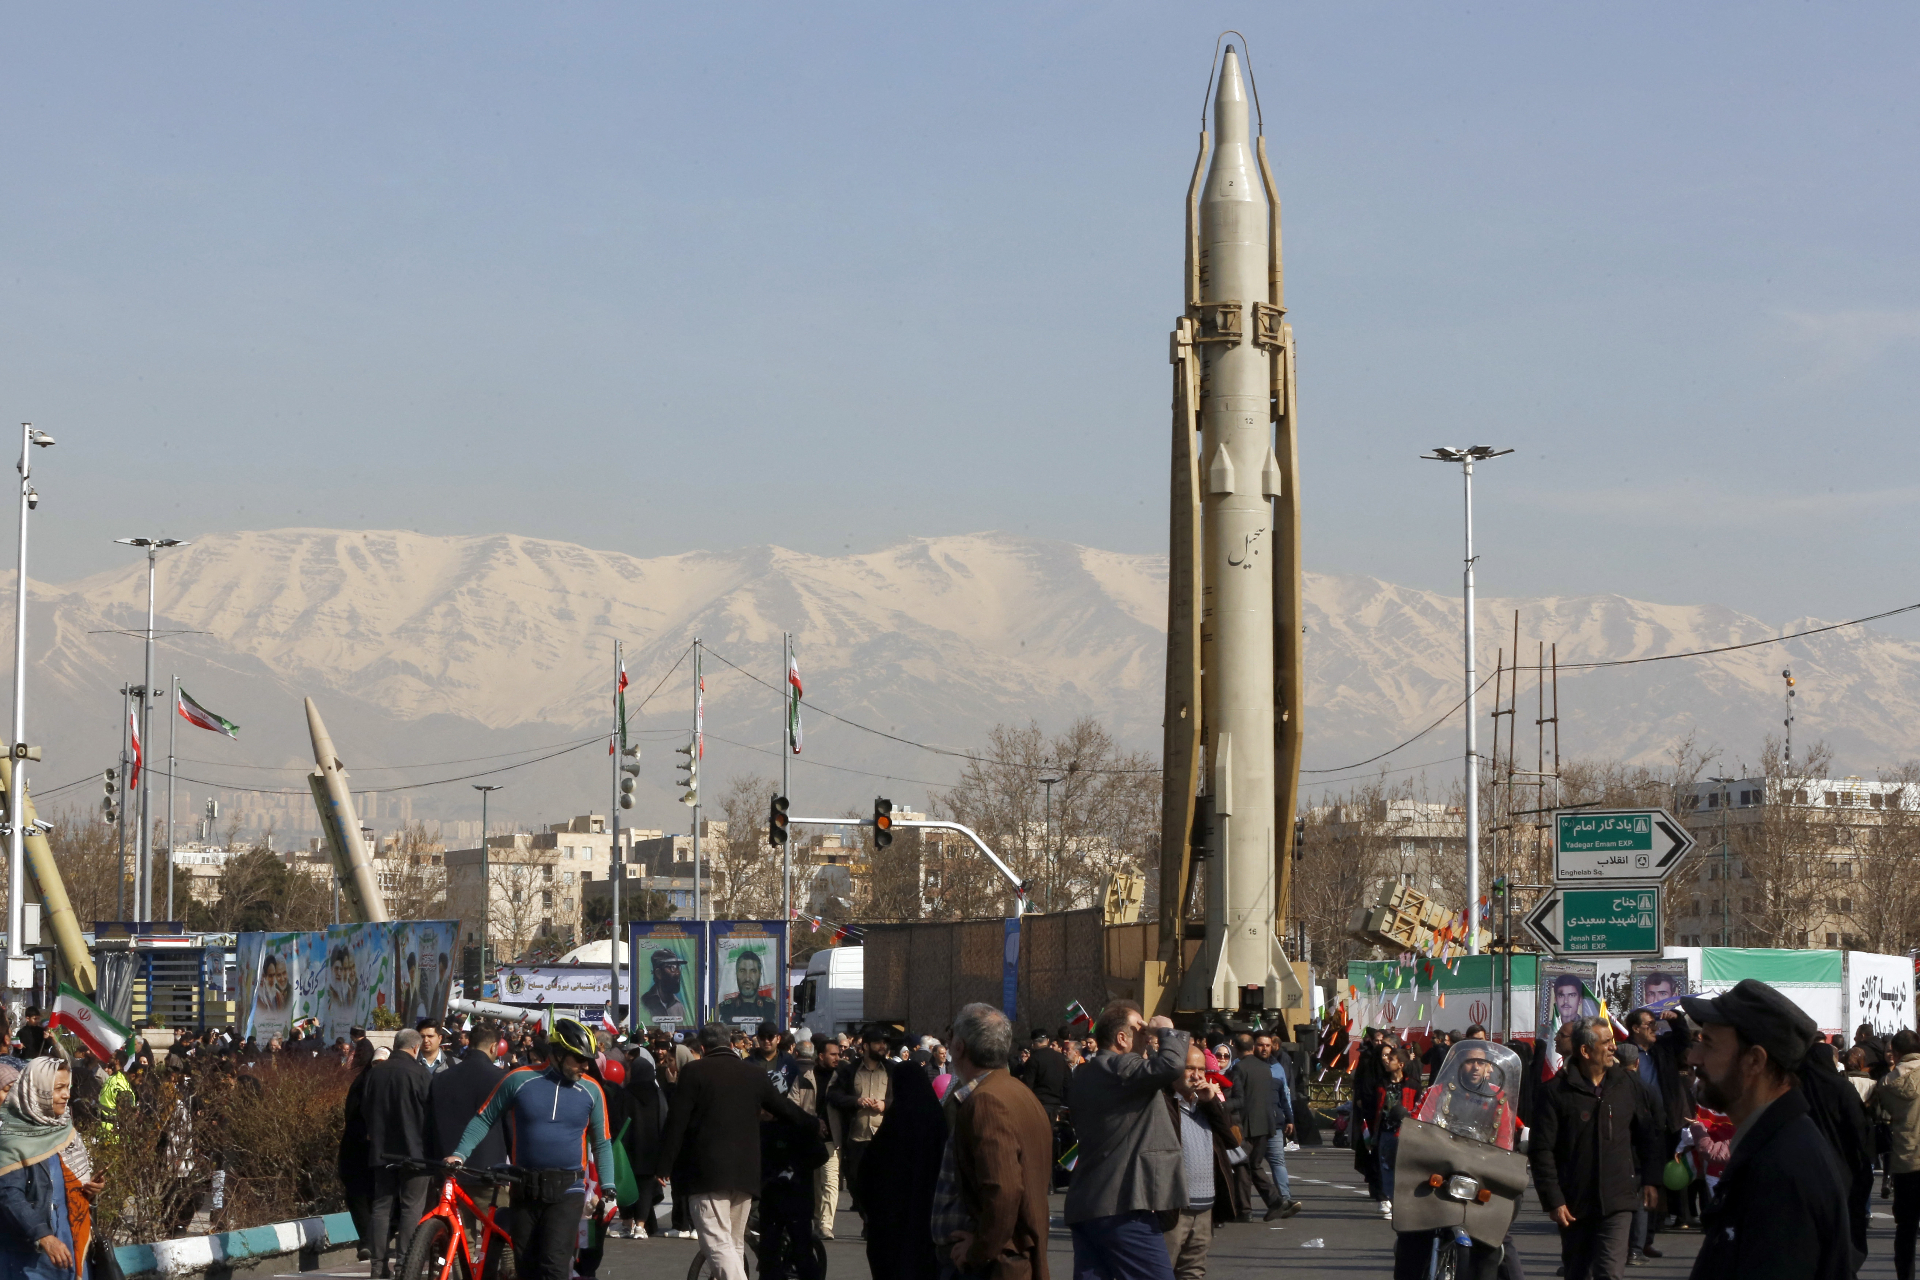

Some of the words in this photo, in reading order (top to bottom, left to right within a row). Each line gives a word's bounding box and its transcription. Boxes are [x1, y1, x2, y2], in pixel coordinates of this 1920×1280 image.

[1227, 527, 1266, 570] سجیل
[1573, 820, 1595, 836] امام
[1565, 841, 1593, 849] Yadegar
[1595, 840, 1616, 848] Emam
[1597, 856, 1628, 867] انقلاب
[1612, 896, 1637, 911] جناح
[1567, 916, 1606, 927] سعیدی
[1608, 913, 1637, 927] شهید
[1248, 928, 1257, 936] 16
[528, 981, 543, 990] مسلح
[570, 982, 596, 992] پشتیبانی
